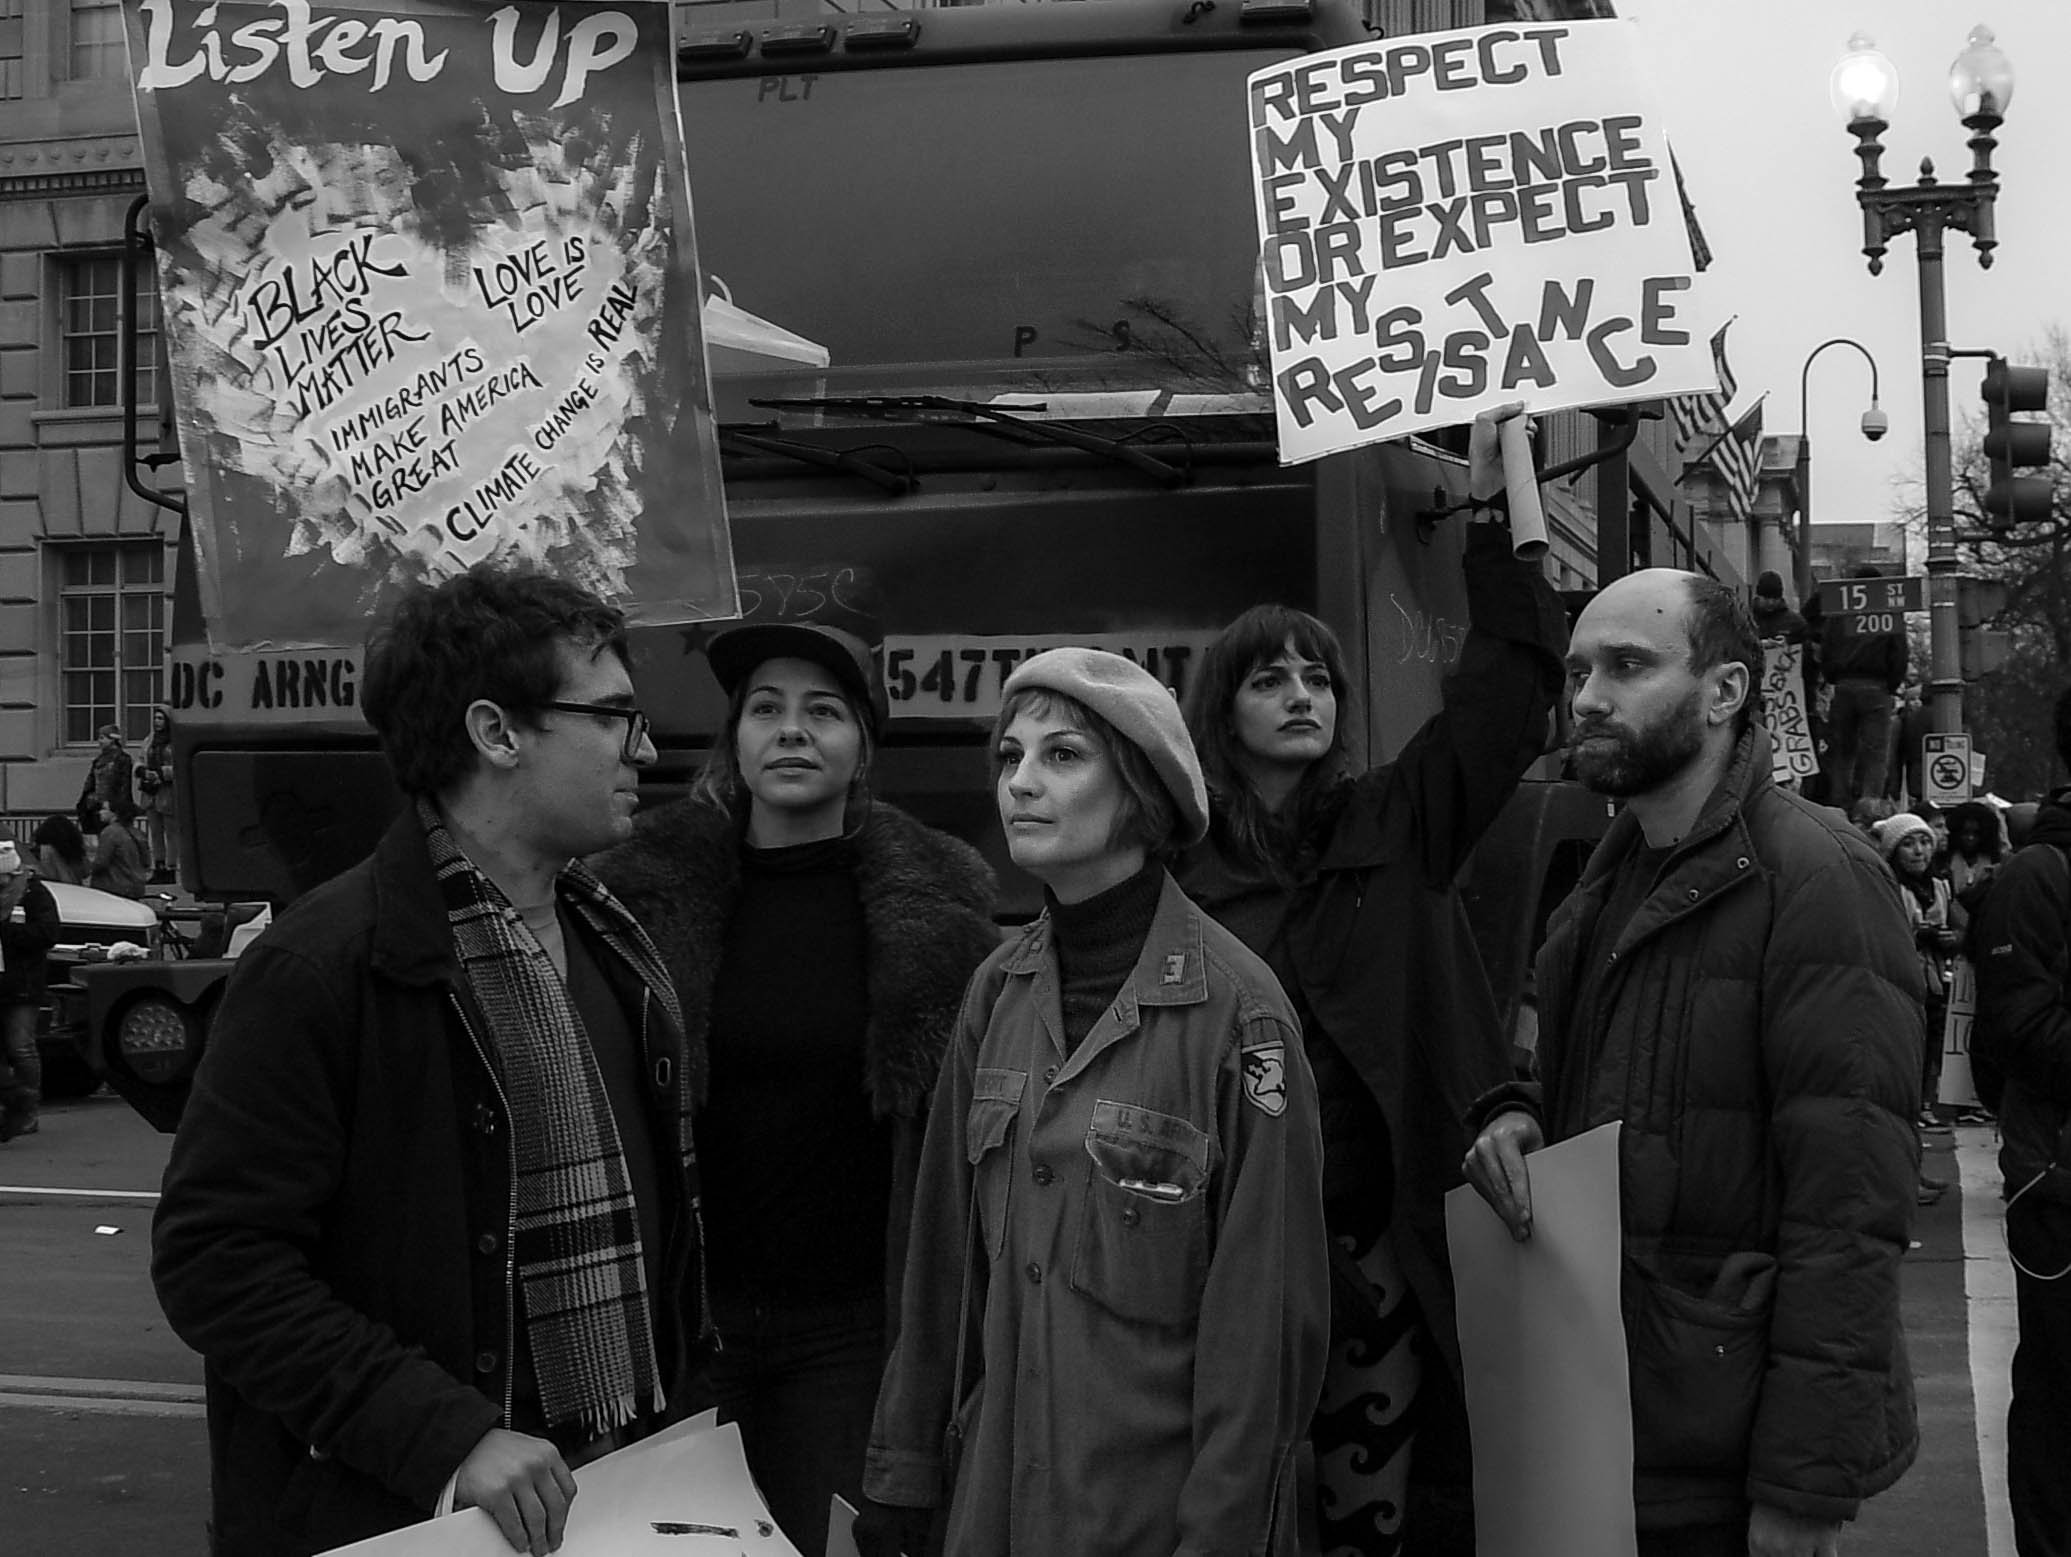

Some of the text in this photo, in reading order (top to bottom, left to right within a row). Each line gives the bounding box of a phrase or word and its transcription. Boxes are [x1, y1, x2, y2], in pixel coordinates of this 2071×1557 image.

[138, 0, 449, 92] Listen
[758, 74, 818, 103] PLT
[1251, 29, 1569, 128] RESPECT
[1256, 106, 1361, 178] MY
[1263, 116, 1652, 234] EXISTENCE
[473, 236, 586, 309] LOVE IS
[1264, 168, 1659, 293] OR EXPECT
[248, 234, 411, 351] BLACK
[507, 264, 585, 333] LOVE
[1271, 274, 1377, 351] MY
[274, 298, 371, 389] LIVES
[297, 312, 432, 421] MATTER
[1277, 273, 1691, 430] RESISTANCE
[331, 348, 484, 451] IMMIGRANTS
[350, 362, 543, 485] MAKE AMERICA
[446, 284, 638, 541] CLIMATE CHANGE IS REAL
[372, 439, 459, 509] GREAT
[1840, 583, 1903, 610] 15 ST
[1856, 614, 1893, 633] 200
[171, 660, 355, 709] DC ARNG
[1775, 690, 1813, 774] GRABS
